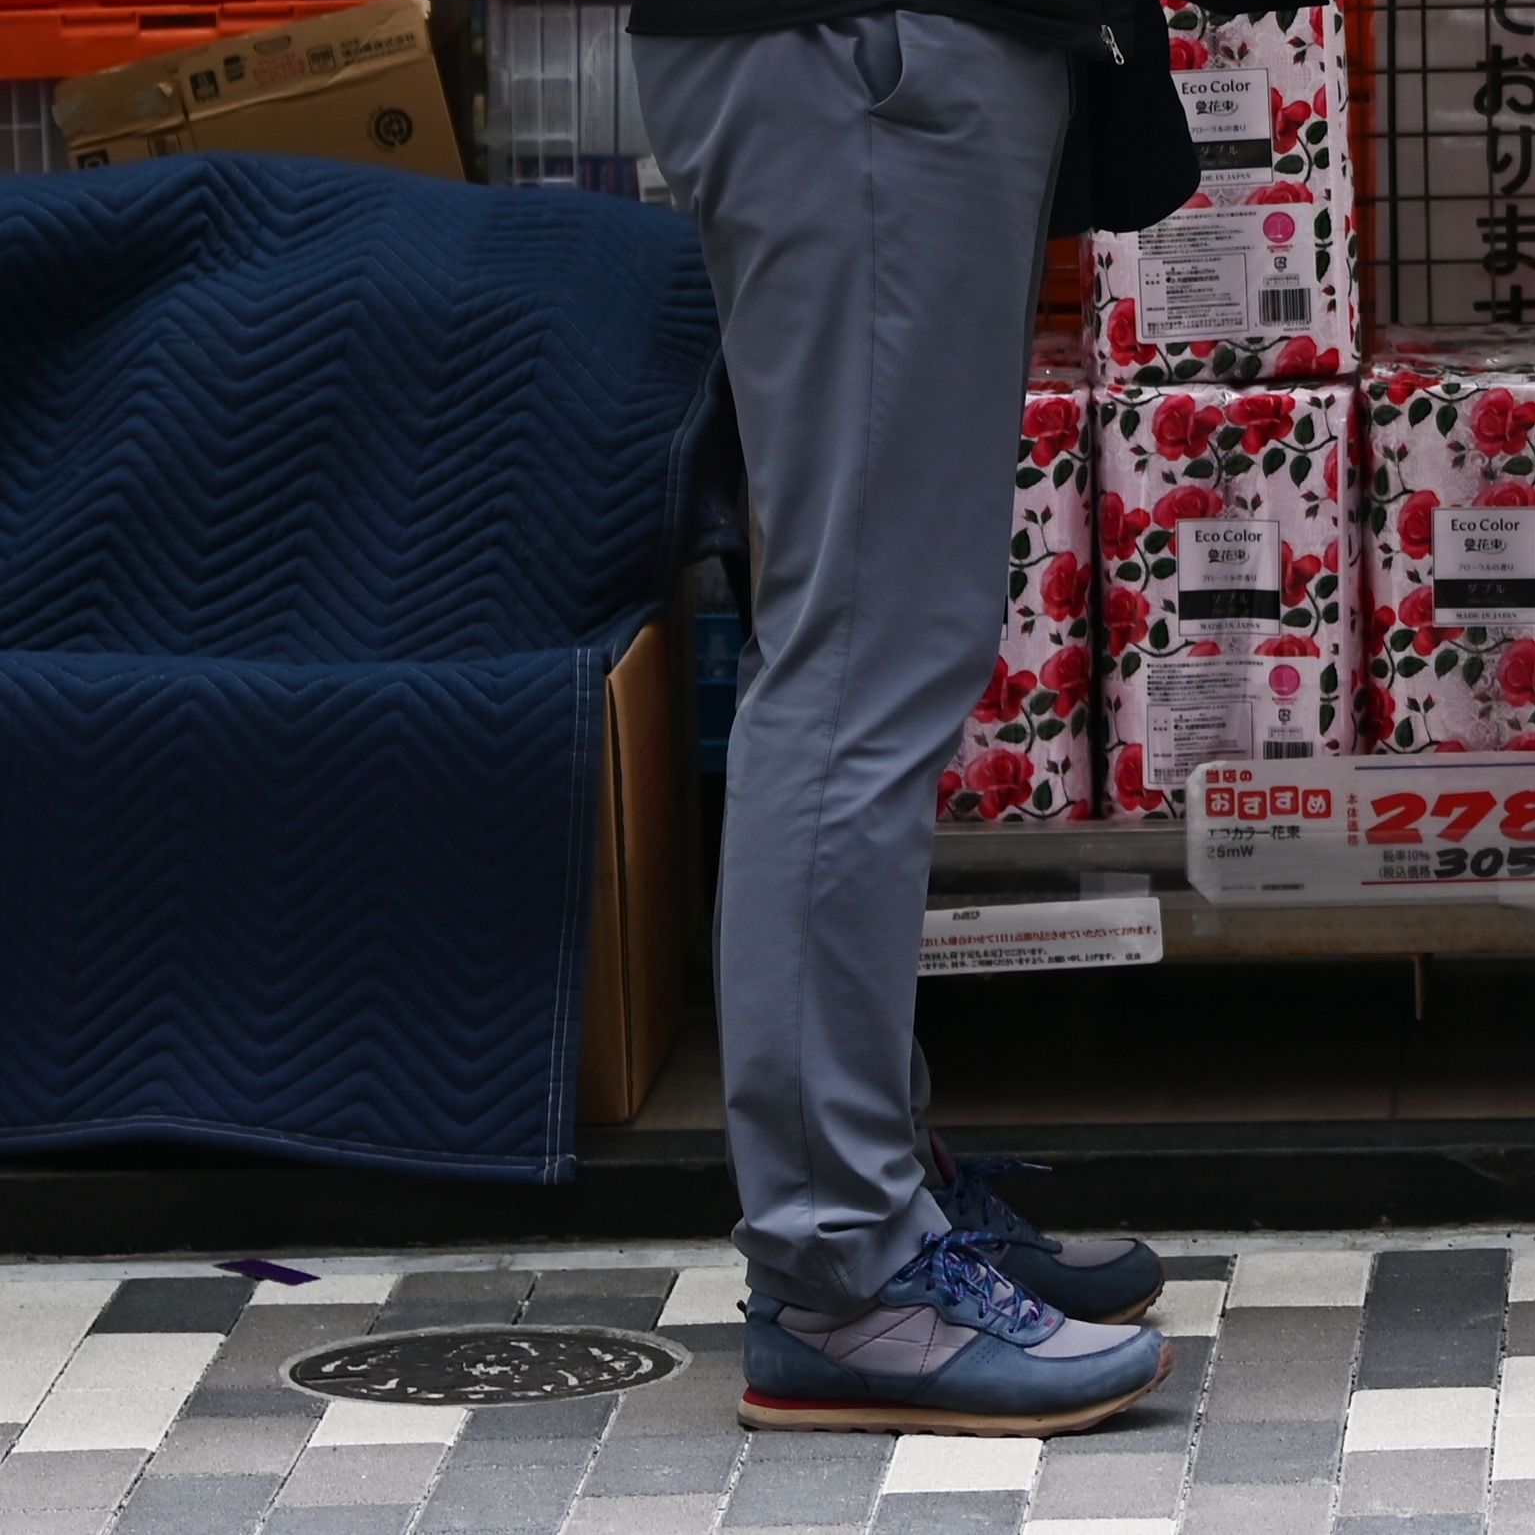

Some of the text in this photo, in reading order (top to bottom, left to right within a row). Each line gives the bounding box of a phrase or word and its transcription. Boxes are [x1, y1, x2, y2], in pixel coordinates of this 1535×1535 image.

[1182, 79, 1251, 94] Eco Color
[1451, 518, 1520, 531] Eco Color
[1195, 529, 1262, 543] Eco Color
[1206, 770, 1252, 783] 当店の
[1208, 788, 1328, 818] おすすめ
[1347, 794, 1359, 846] 本体価格
[1206, 825, 1300, 842] エコカラー花束
